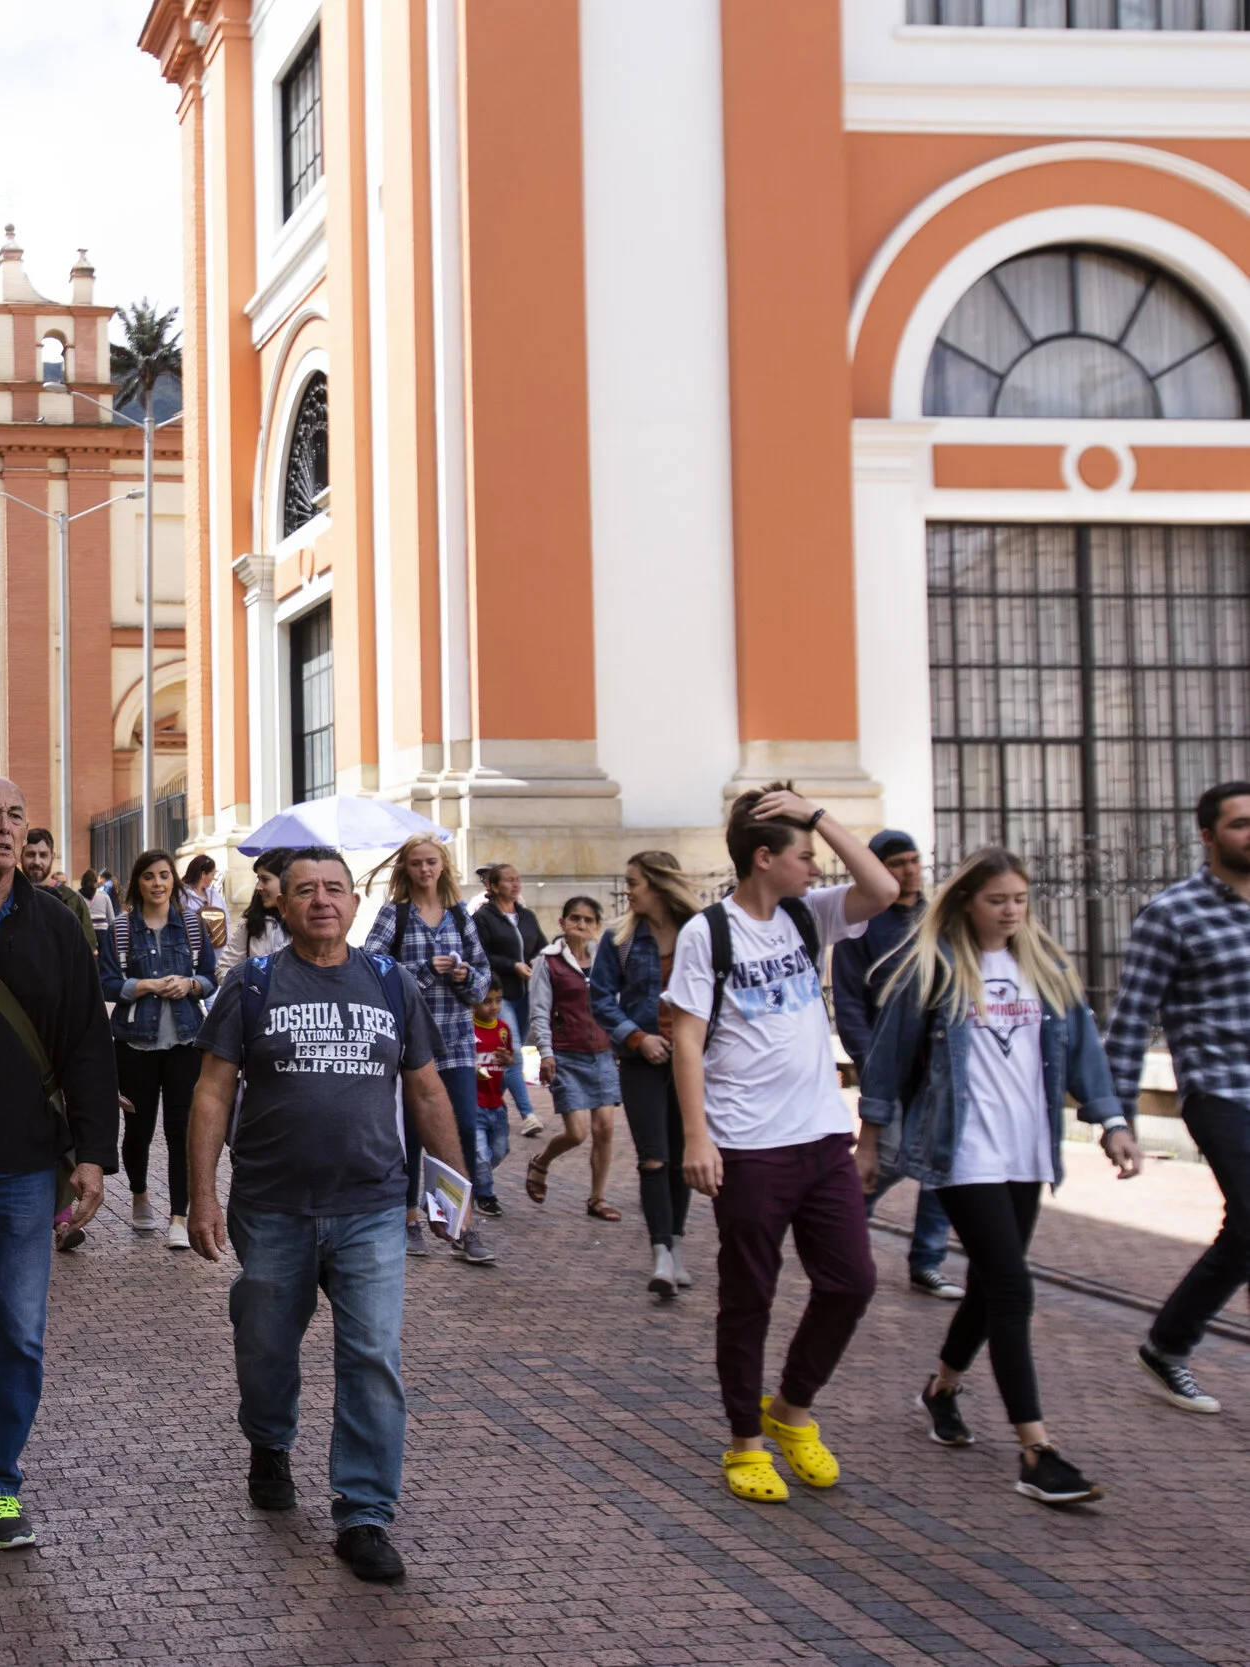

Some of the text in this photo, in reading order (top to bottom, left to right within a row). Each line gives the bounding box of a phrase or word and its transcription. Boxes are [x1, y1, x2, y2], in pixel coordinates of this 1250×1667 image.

[264, 1002, 396, 1041] JOSHUA TREE
[290, 1029, 377, 1044] NATIONAL PARK
[274, 1060, 386, 1077] CALIFORNIA
